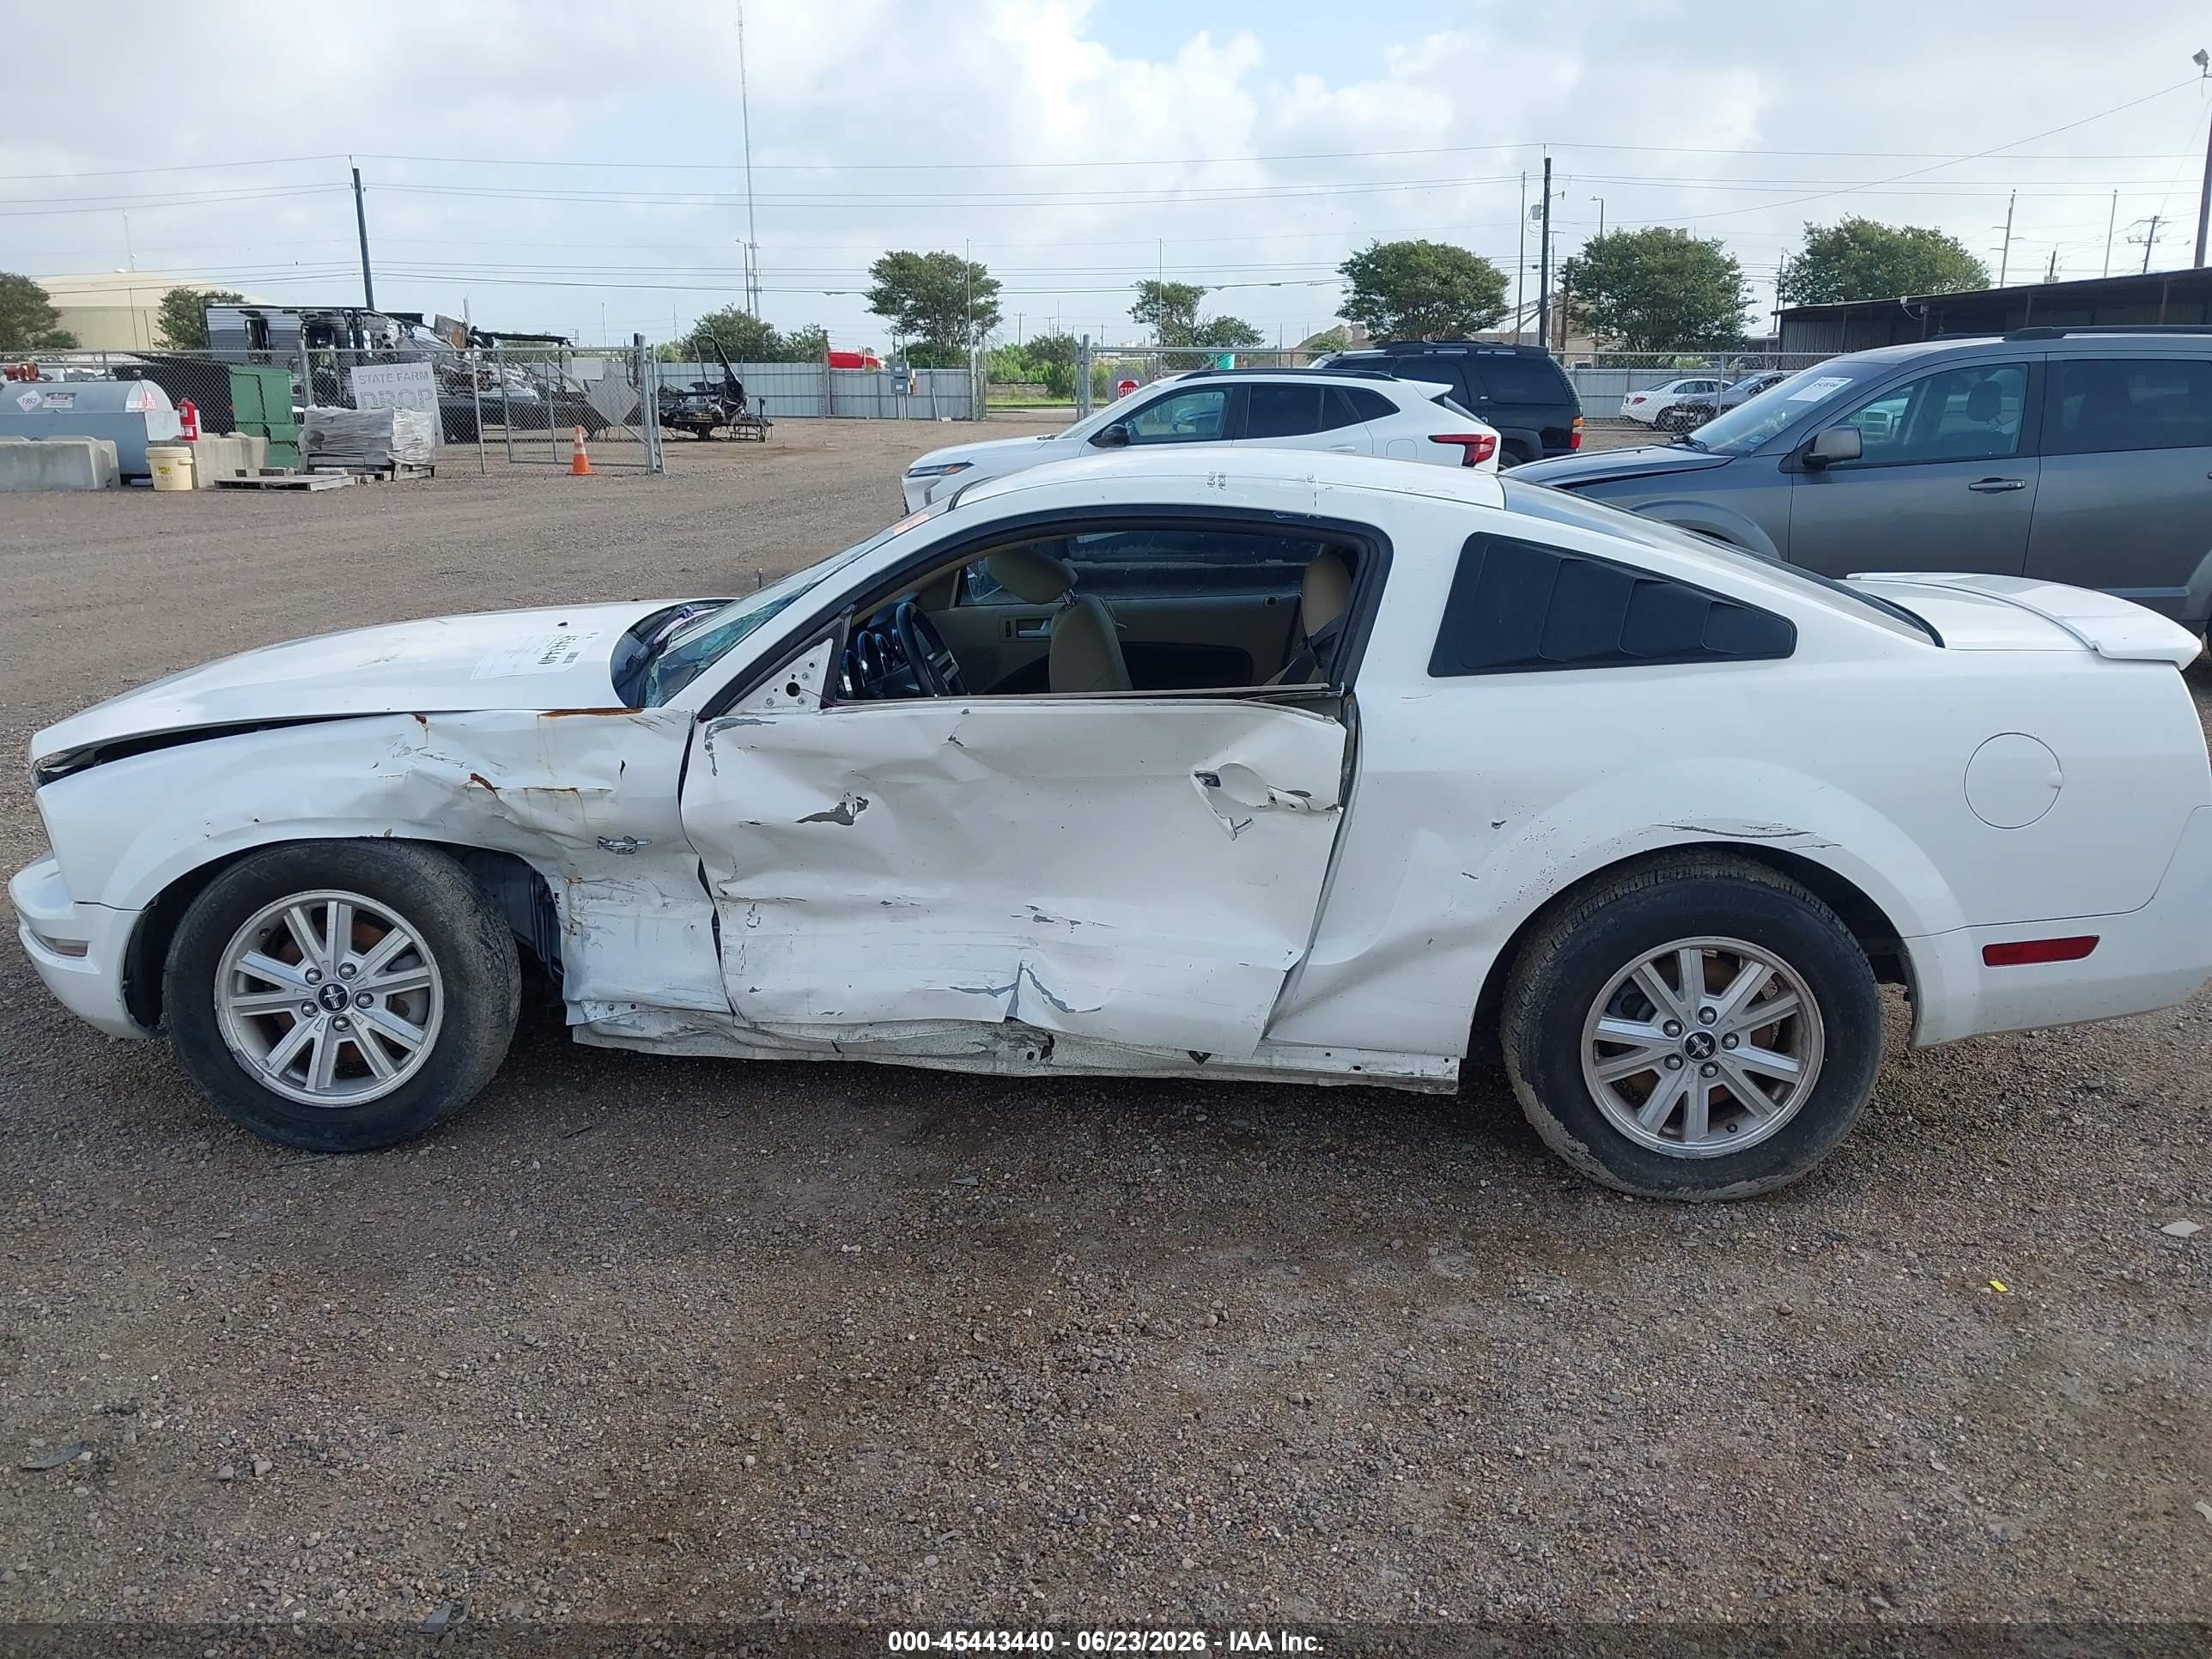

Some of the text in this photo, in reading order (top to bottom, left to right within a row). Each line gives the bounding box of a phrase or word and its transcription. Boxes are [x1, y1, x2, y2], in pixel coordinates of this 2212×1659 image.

[358, 371, 428, 385] STATE FARM
[360, 388, 433, 410] DROP
